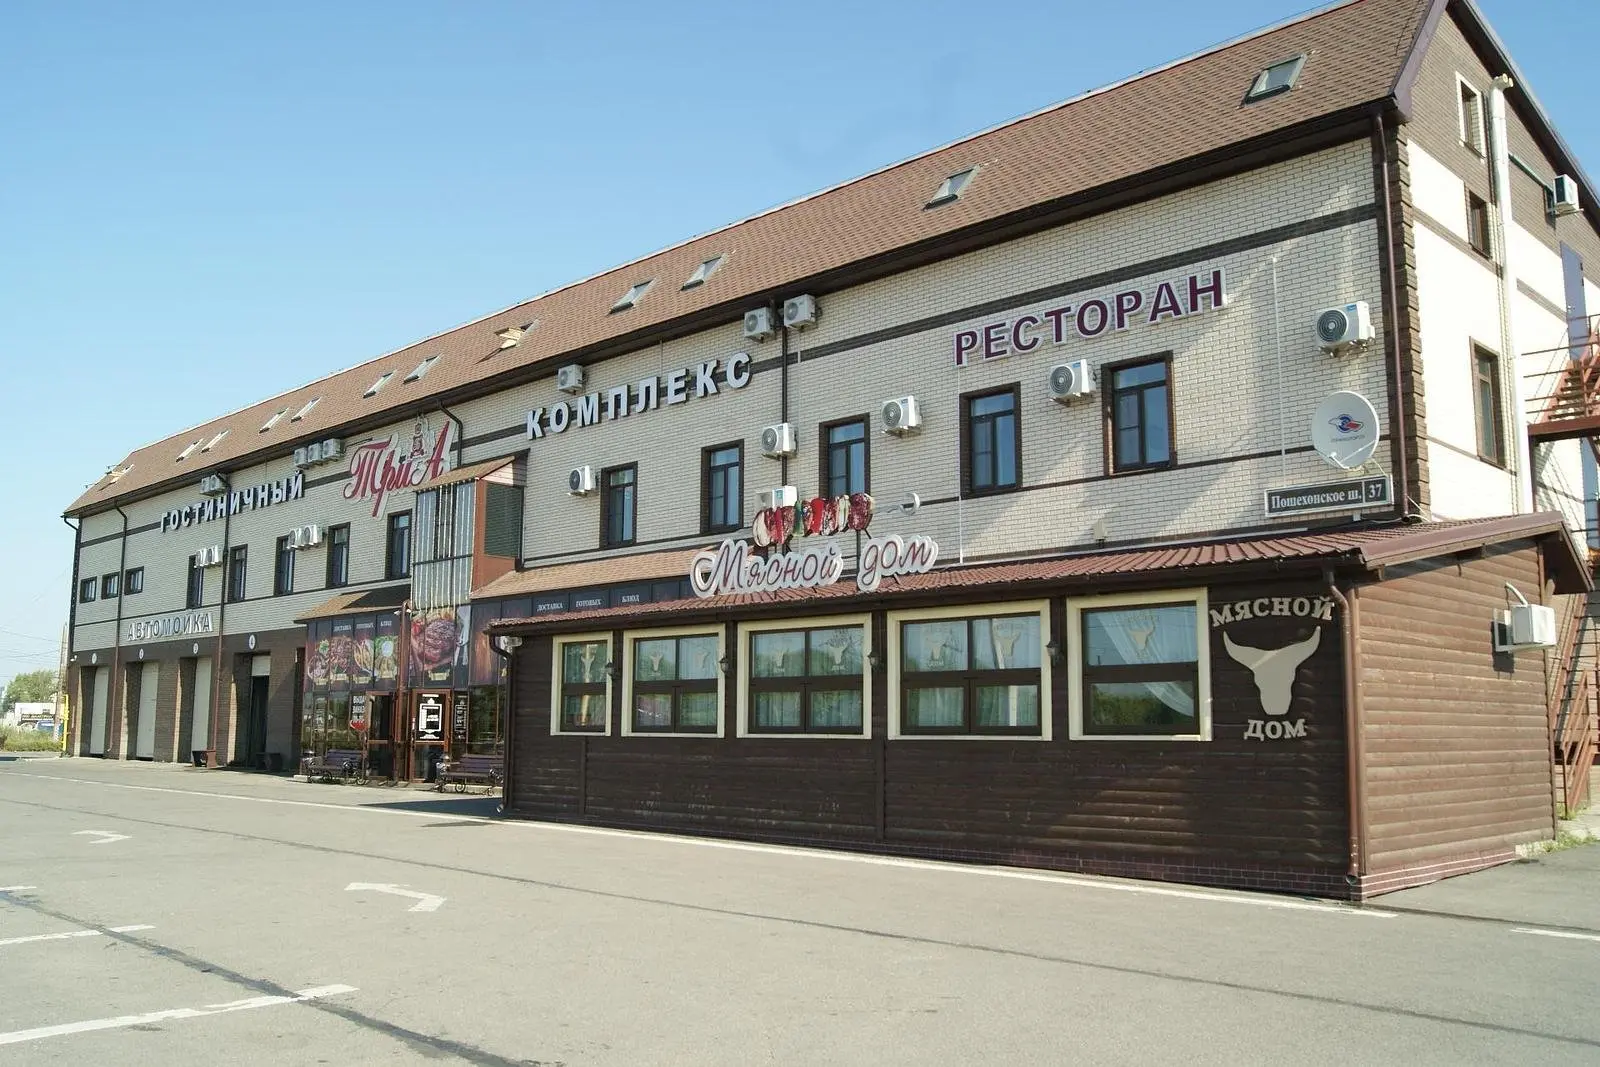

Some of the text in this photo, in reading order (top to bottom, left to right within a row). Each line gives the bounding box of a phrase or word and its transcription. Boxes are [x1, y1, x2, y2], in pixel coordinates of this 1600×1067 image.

[954, 269, 1225, 367] РЕСТОРАН
[526, 352, 752, 440] КОМПЛЕКС
[160, 470, 305, 533] ГОСТИНИЧНЫЙ
[1271, 491, 1346, 509] Пошехонское
[1368, 483, 1383, 499] 37
[692, 537, 935, 595] Мясной дом
[536, 602, 563, 612] ДОСТАВКА
[621, 594, 640, 603] БЛЮД
[1209, 596, 1335, 627] МЯСНОЙ
[1243, 718, 1308, 742] ДОМ
